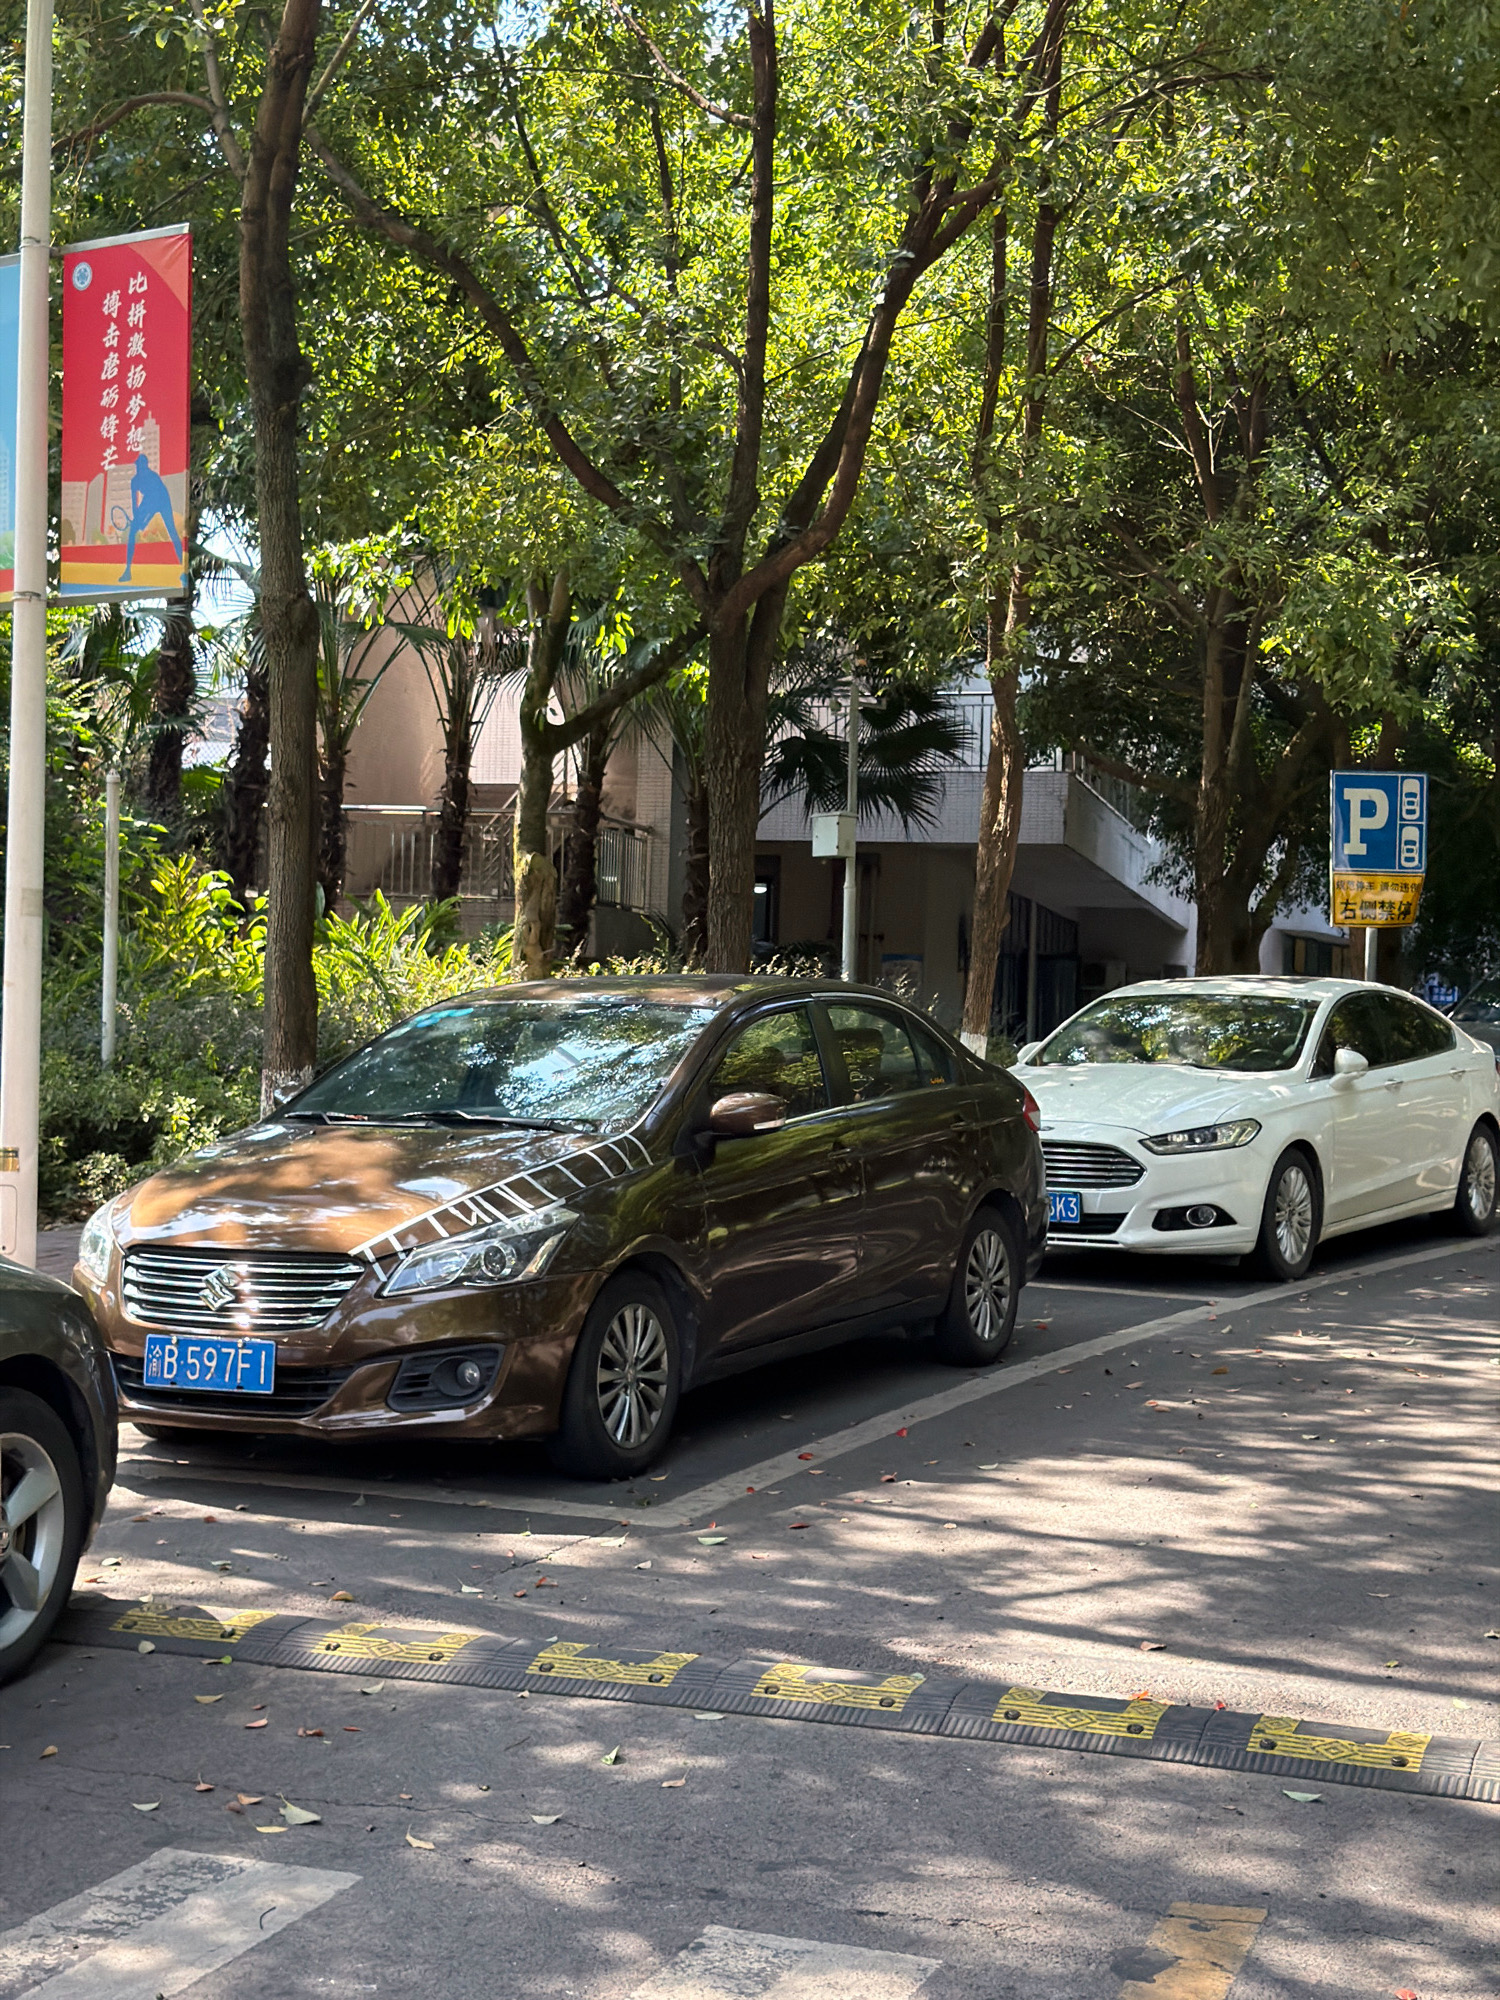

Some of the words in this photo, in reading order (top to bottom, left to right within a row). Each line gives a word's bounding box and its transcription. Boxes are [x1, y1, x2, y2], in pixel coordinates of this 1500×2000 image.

[99, 289, 122, 472] 搏击磨砺锋芒
[125, 271, 148, 453] 比拼激扬梦想
[1343, 788, 1389, 855] P
[1340, 898, 1412, 921] 右侧禁停
